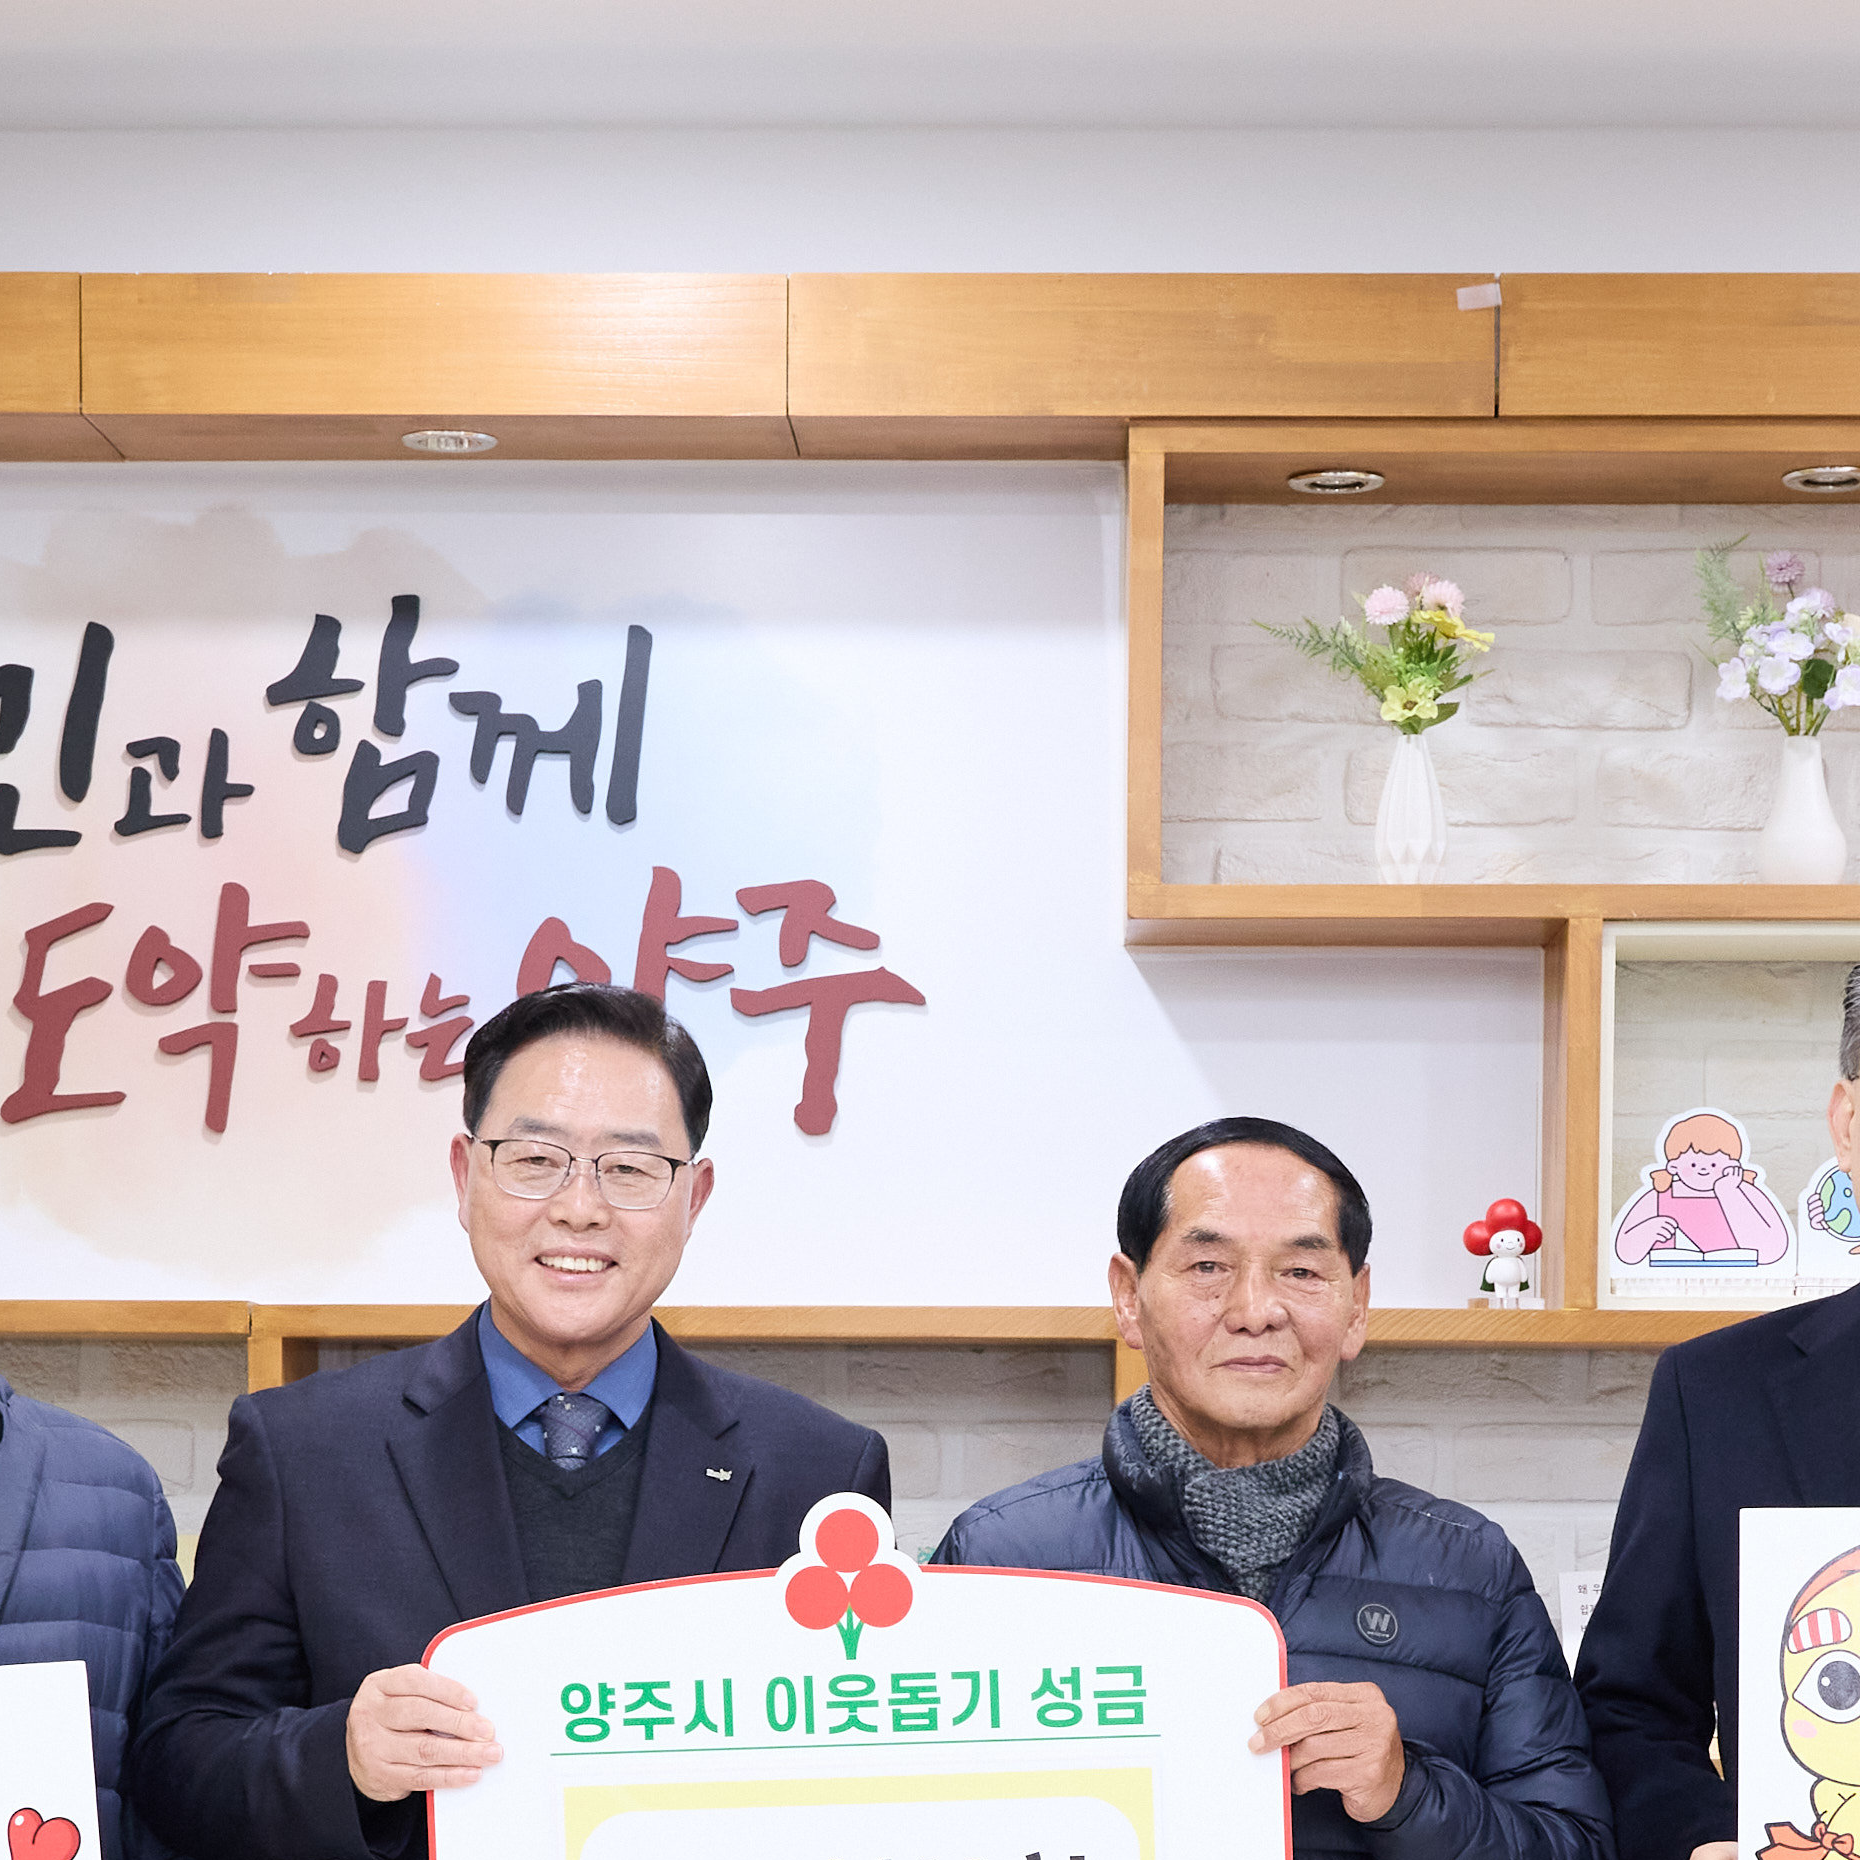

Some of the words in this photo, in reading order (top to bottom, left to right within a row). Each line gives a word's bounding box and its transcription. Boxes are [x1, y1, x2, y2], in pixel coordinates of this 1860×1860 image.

[265, 593, 655, 856] 함께
[0, 880, 478, 1136] 도약하는
[559, 1677, 736, 1743] 양주시
[765, 1667, 1002, 1737] 이웃돕기
[1029, 1664, 1149, 1727] 성금
[1362, 1610, 1391, 1633] W
